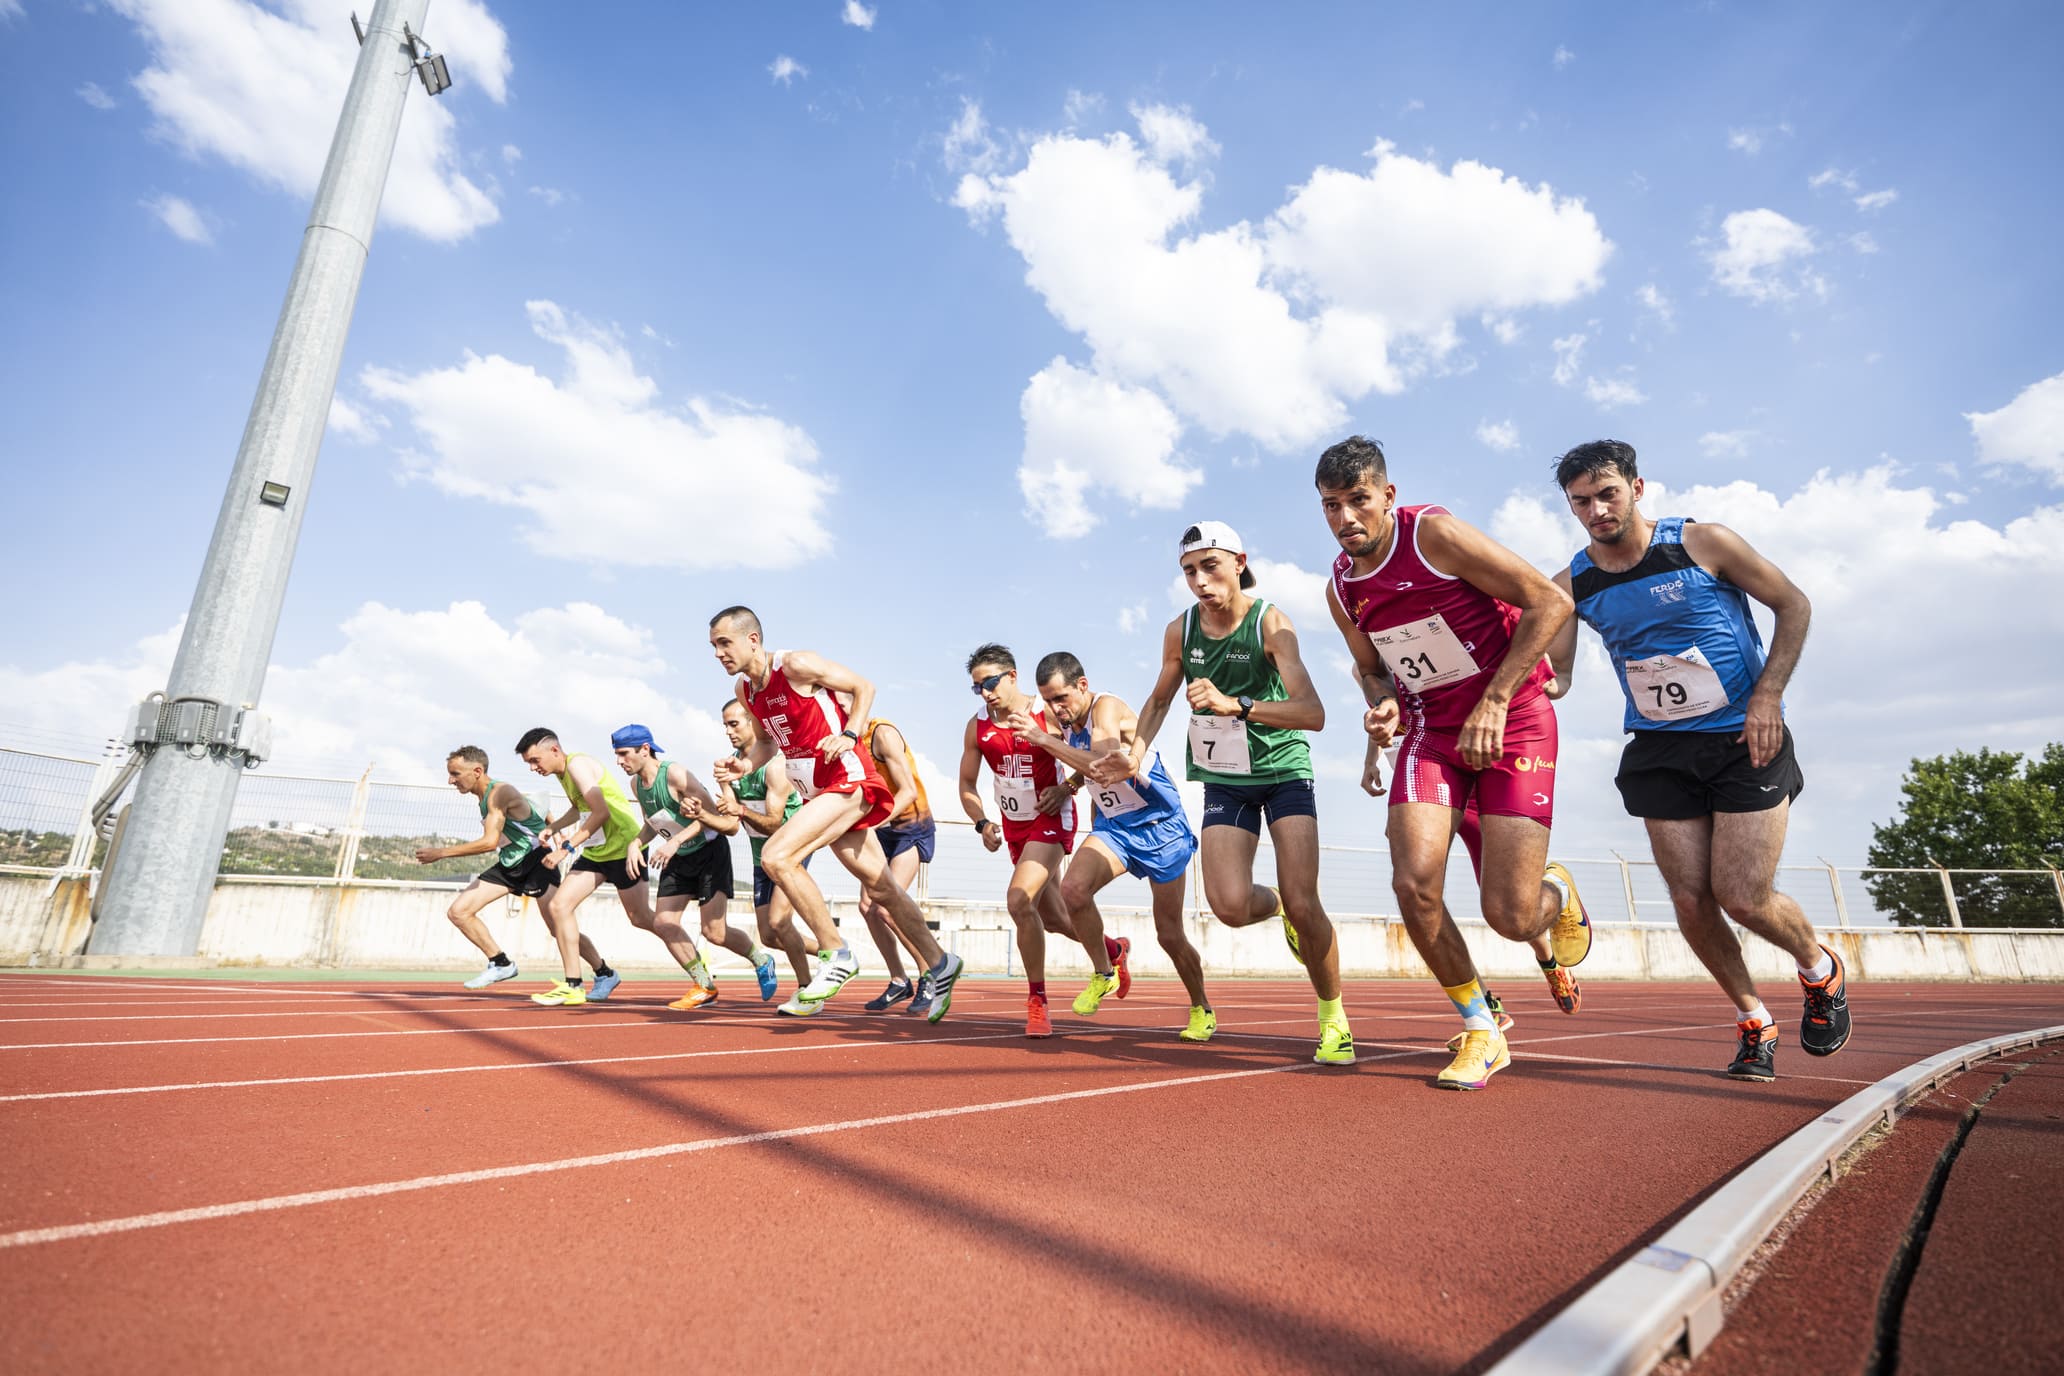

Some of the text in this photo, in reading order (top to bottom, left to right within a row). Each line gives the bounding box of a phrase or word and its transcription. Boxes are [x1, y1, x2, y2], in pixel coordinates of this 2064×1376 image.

[1400, 652, 1437, 679] 31
[1648, 682, 1687, 707] 79
[1203, 740, 1216, 760] 7
[1000, 794, 1019, 812] 60
[1100, 791, 1121, 807] 57
